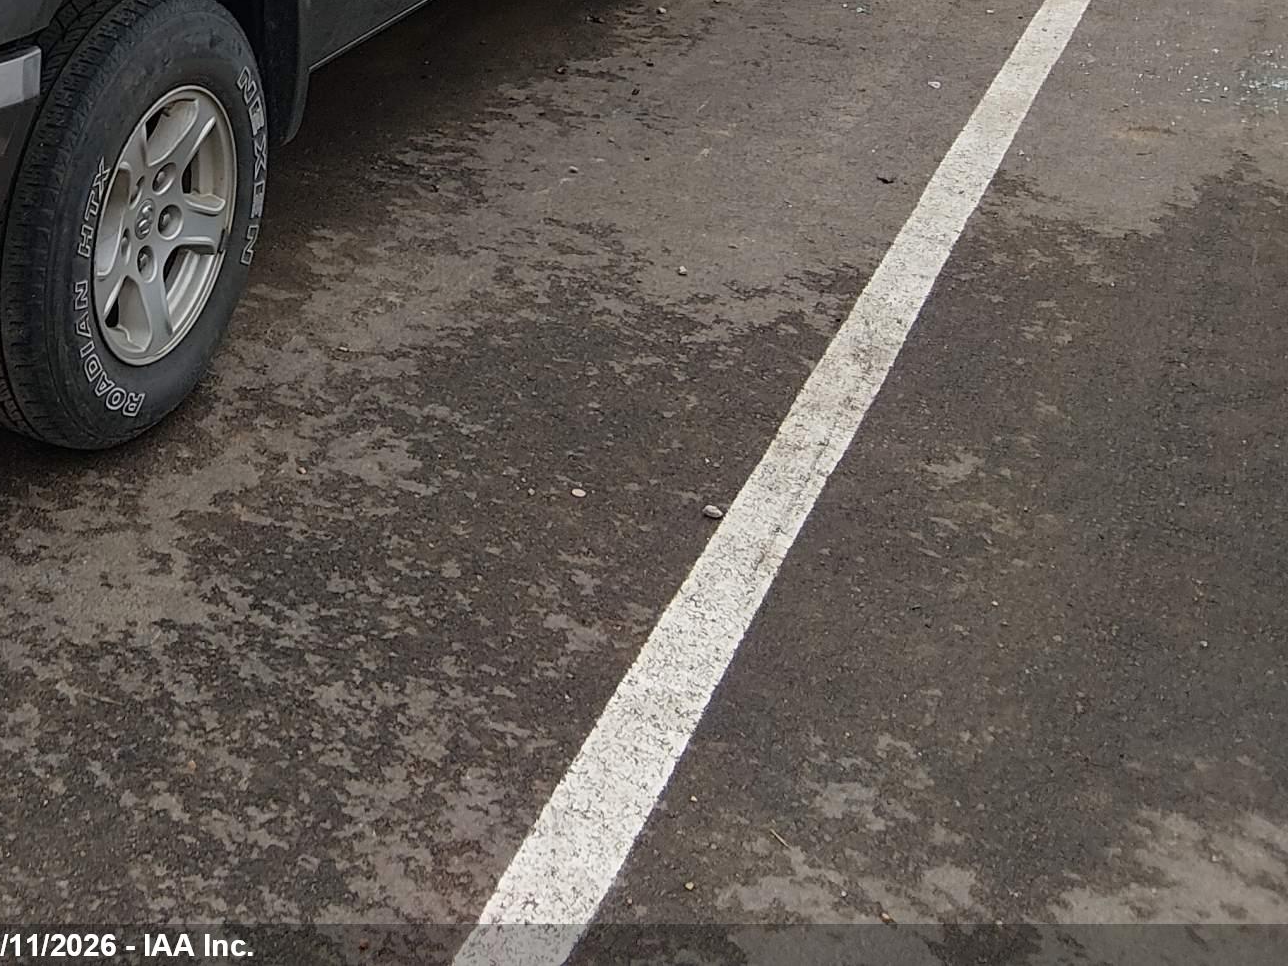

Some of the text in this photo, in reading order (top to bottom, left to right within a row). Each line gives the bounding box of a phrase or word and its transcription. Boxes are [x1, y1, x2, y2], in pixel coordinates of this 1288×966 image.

[235, 66, 269, 266] NEXEN
[73, 156, 146, 418] ROADIAN HTX
